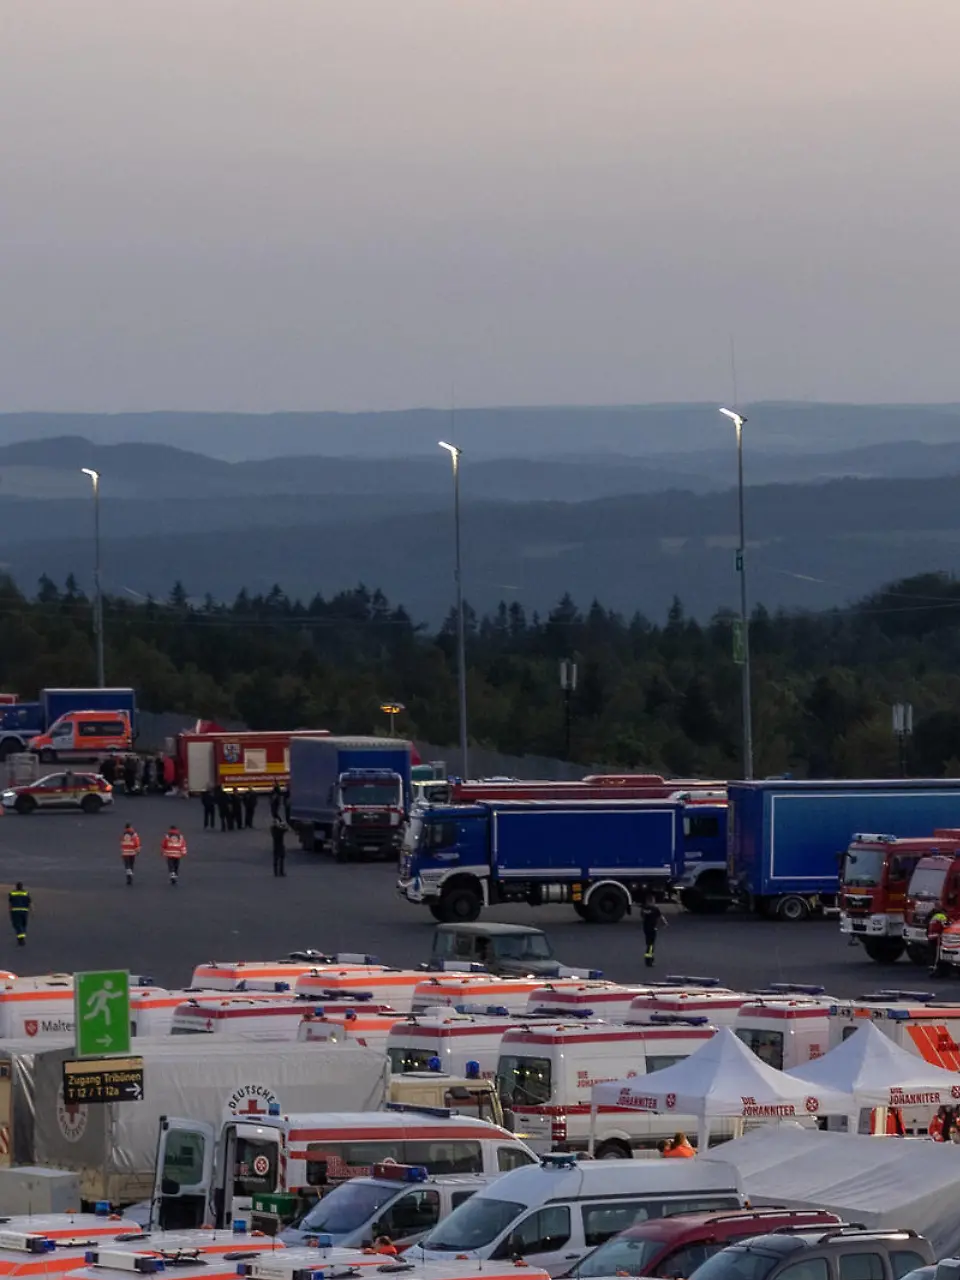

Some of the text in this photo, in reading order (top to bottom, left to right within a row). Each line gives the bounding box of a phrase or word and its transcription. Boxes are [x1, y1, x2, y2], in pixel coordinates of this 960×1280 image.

[41, 1020, 75, 1032] Malte
[69, 1071, 141, 1087] Zugang Tribünen
[889, 1093, 940, 1105] JOHANNITER
[741, 1105, 795, 1116] JOHANNITER
